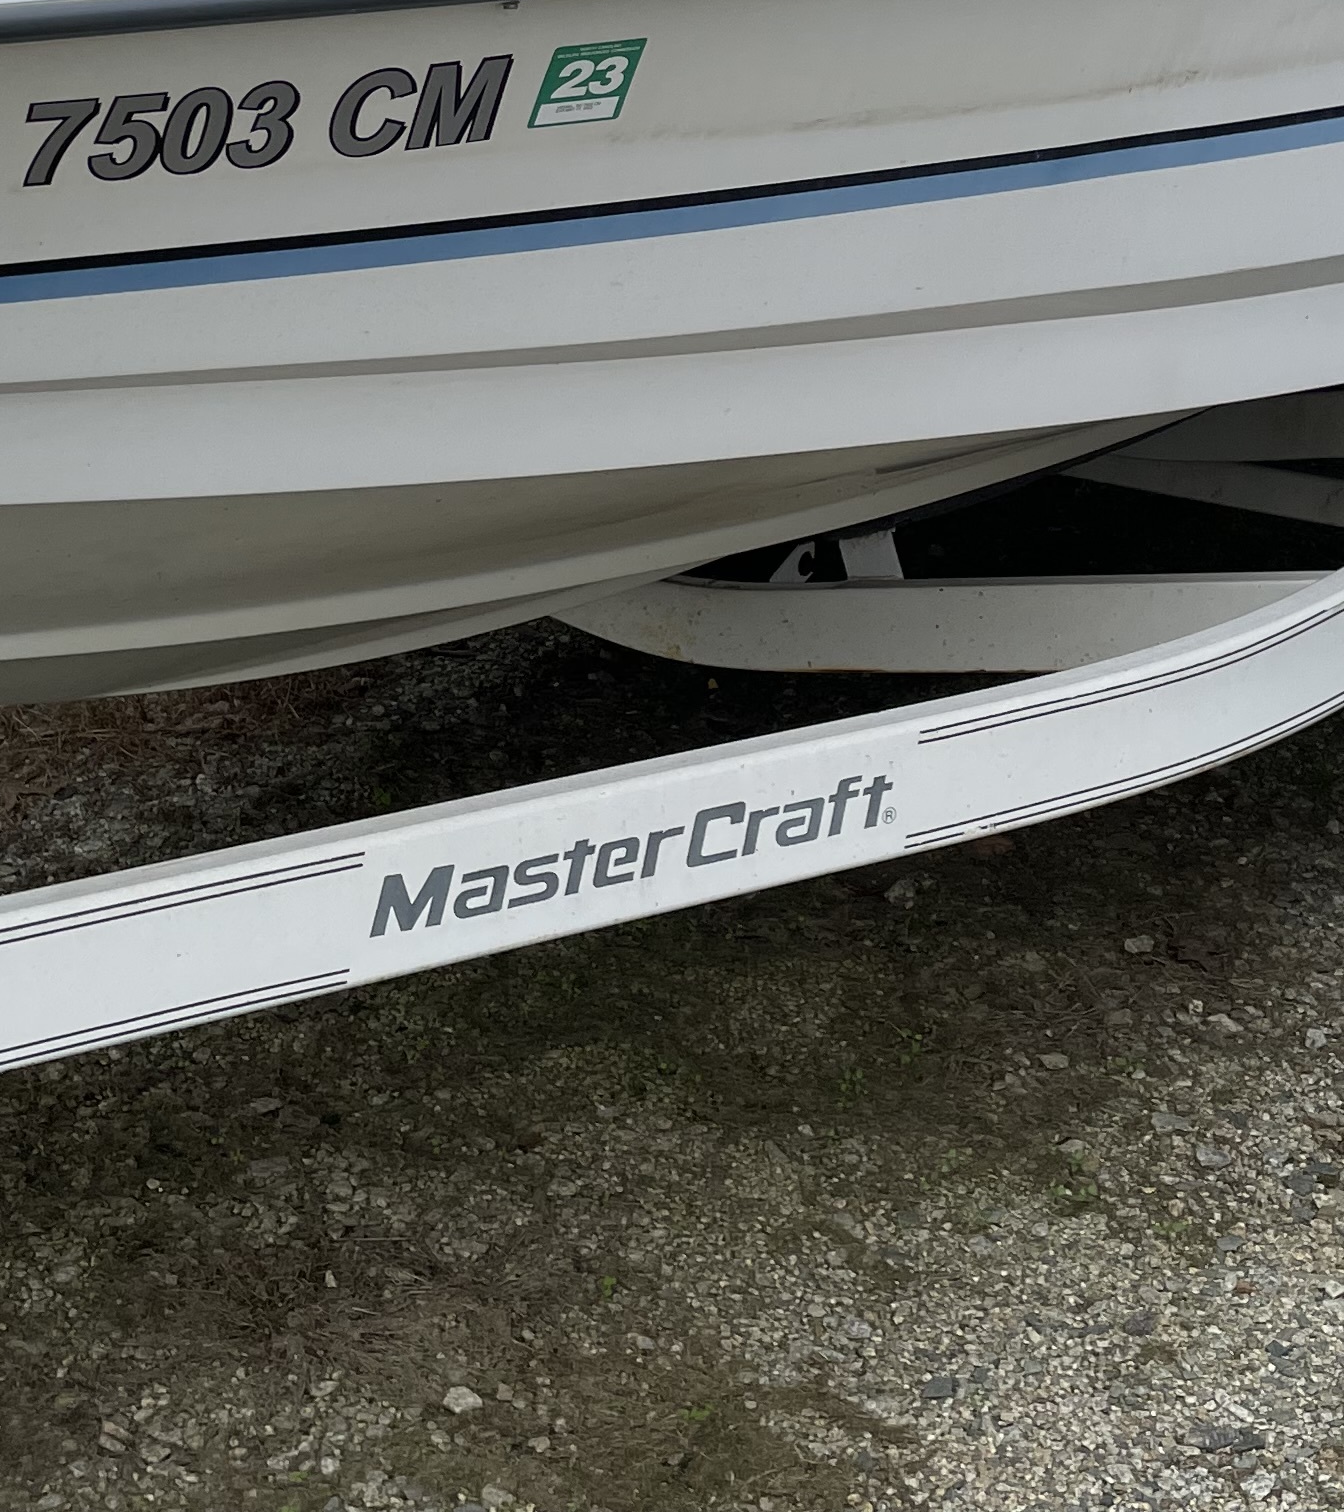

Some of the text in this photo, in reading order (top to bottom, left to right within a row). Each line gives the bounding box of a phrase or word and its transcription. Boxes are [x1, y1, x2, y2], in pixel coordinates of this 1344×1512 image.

[22, 80, 301, 187] 7503
[328, 53, 514, 157] CM
[550, 55, 629, 99] 23
